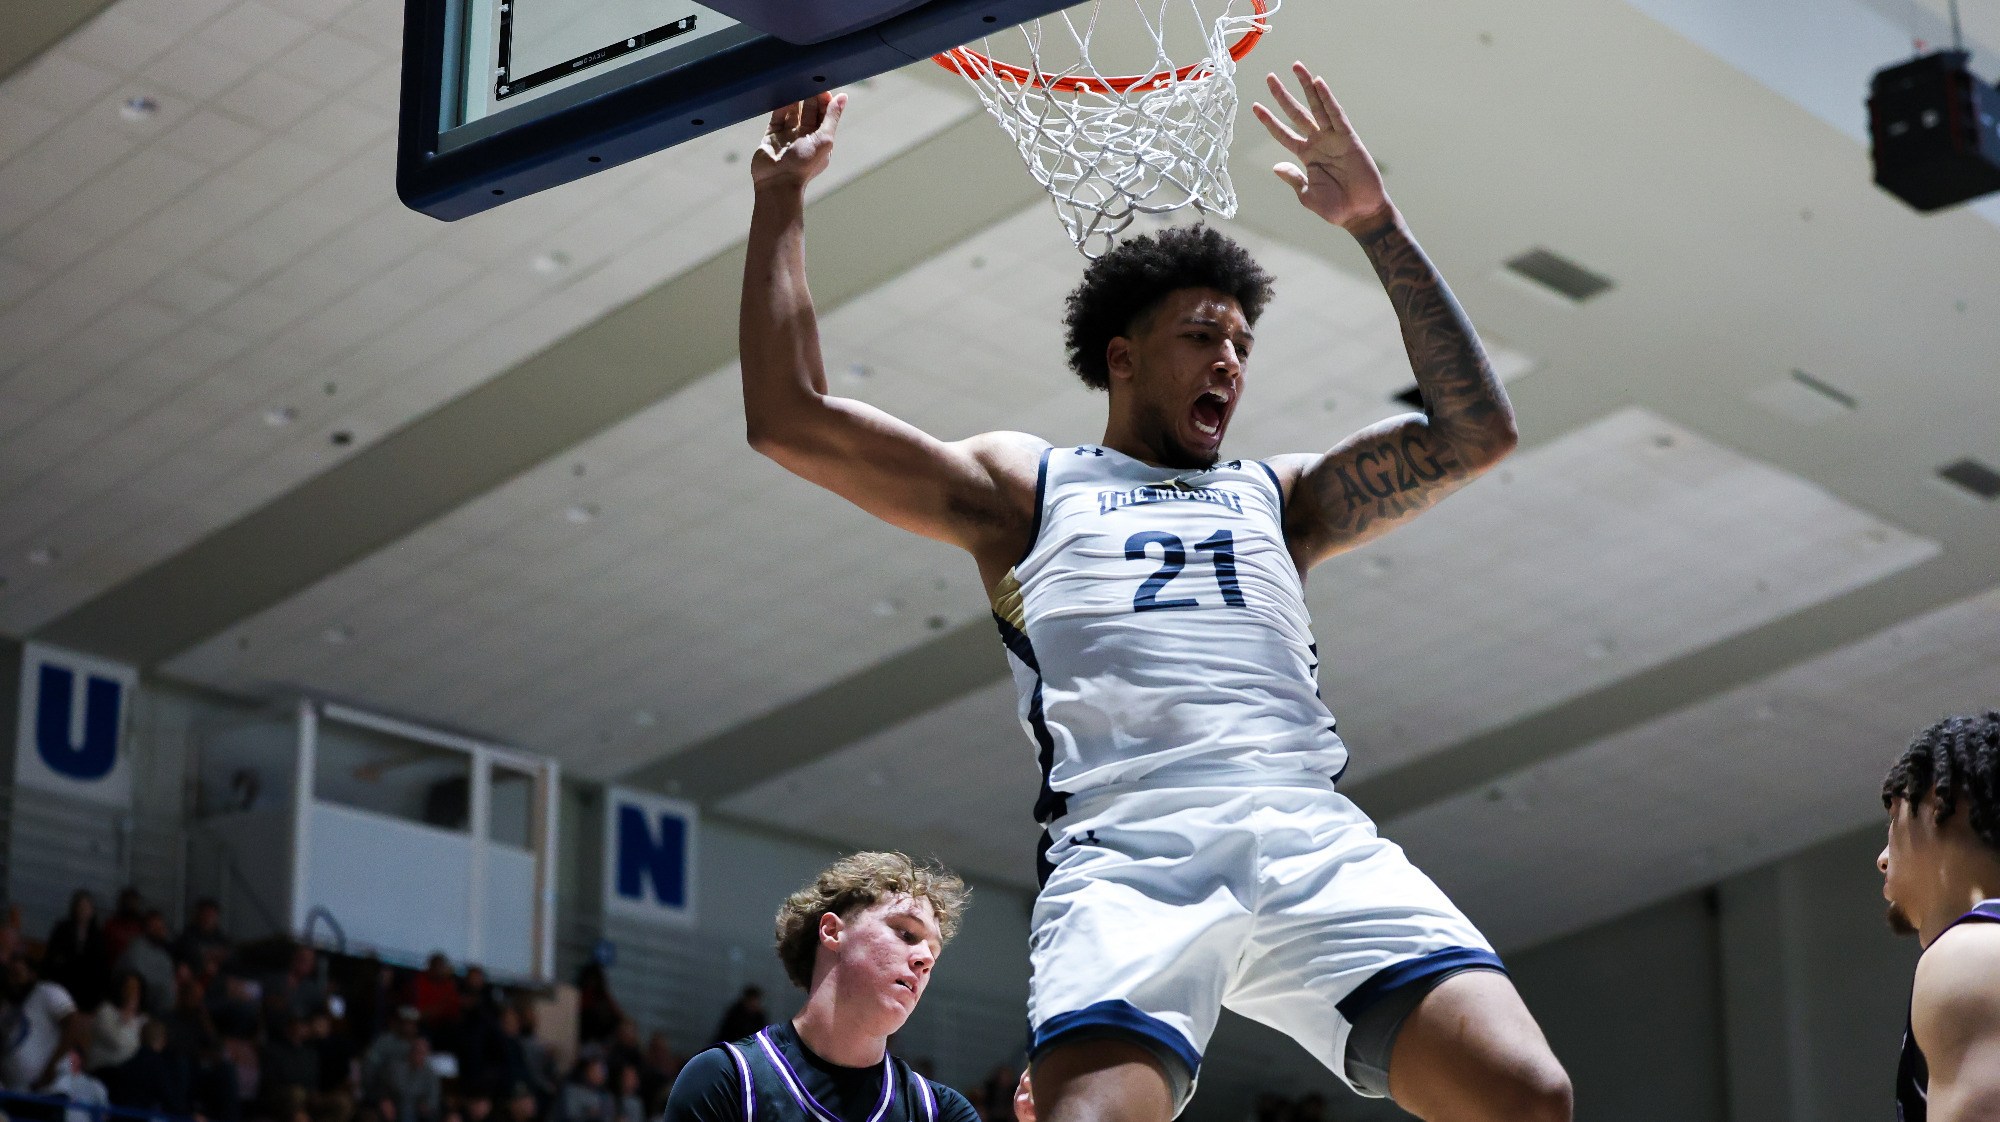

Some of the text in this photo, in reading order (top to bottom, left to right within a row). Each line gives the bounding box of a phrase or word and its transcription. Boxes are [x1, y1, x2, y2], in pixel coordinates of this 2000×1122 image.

[1097, 485, 1149, 514] THE
[1335, 436, 1448, 513] AG2G
[1124, 529, 1247, 613] 21
[36, 663, 121, 780] U
[617, 804, 687, 910] N
